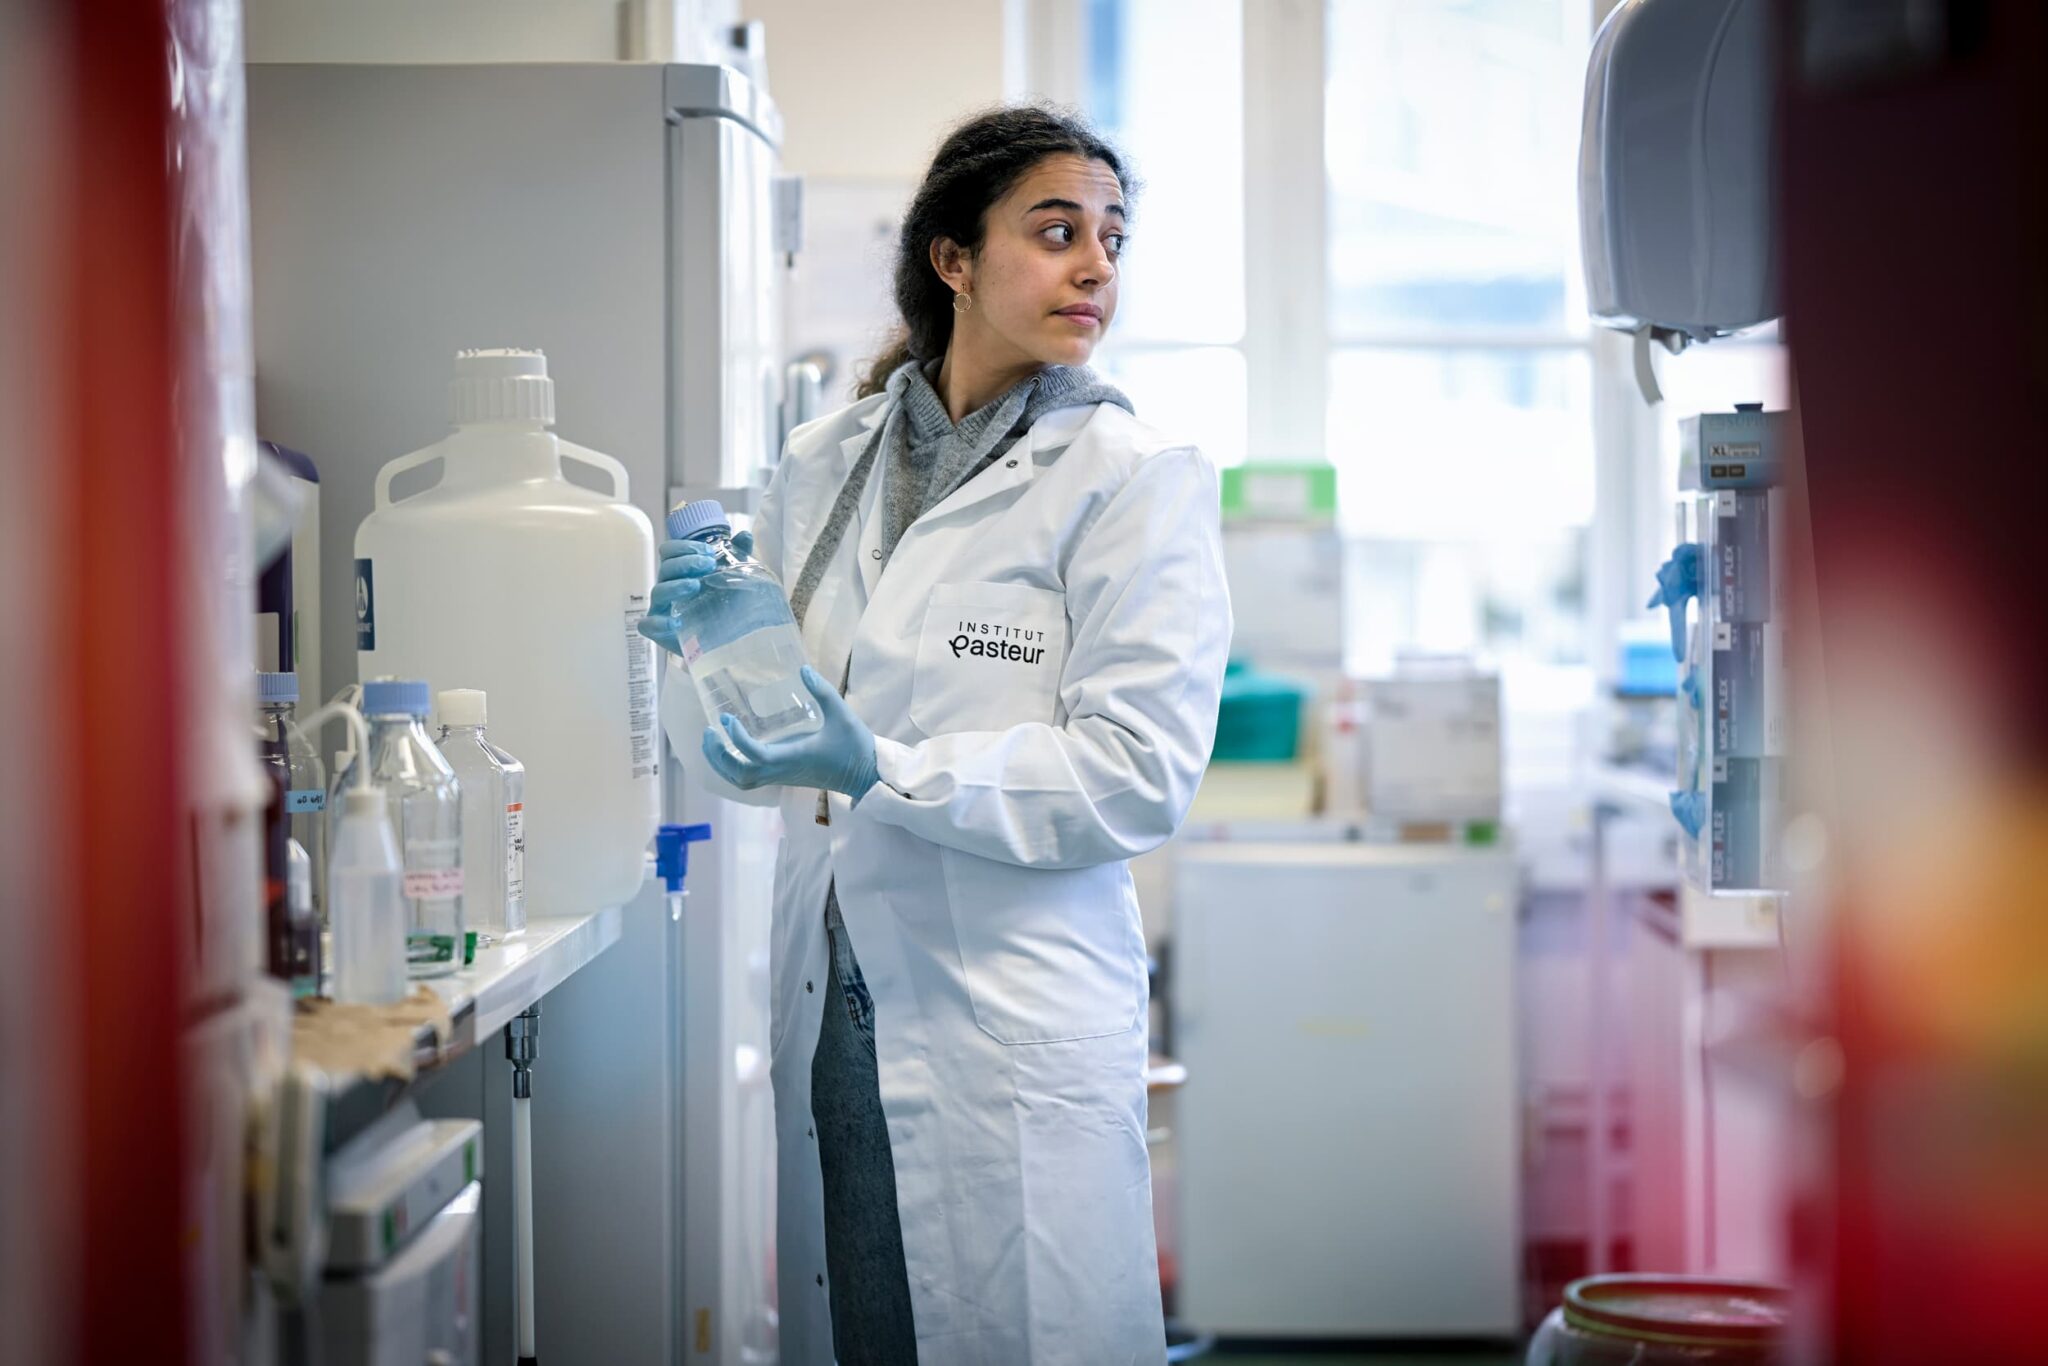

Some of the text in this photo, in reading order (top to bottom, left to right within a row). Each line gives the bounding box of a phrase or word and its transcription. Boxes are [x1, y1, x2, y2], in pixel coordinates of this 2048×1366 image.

[1712, 445, 1726, 456] XL
[958, 621, 1045, 642] INSTITUT
[948, 634, 1045, 665] Pasteur
